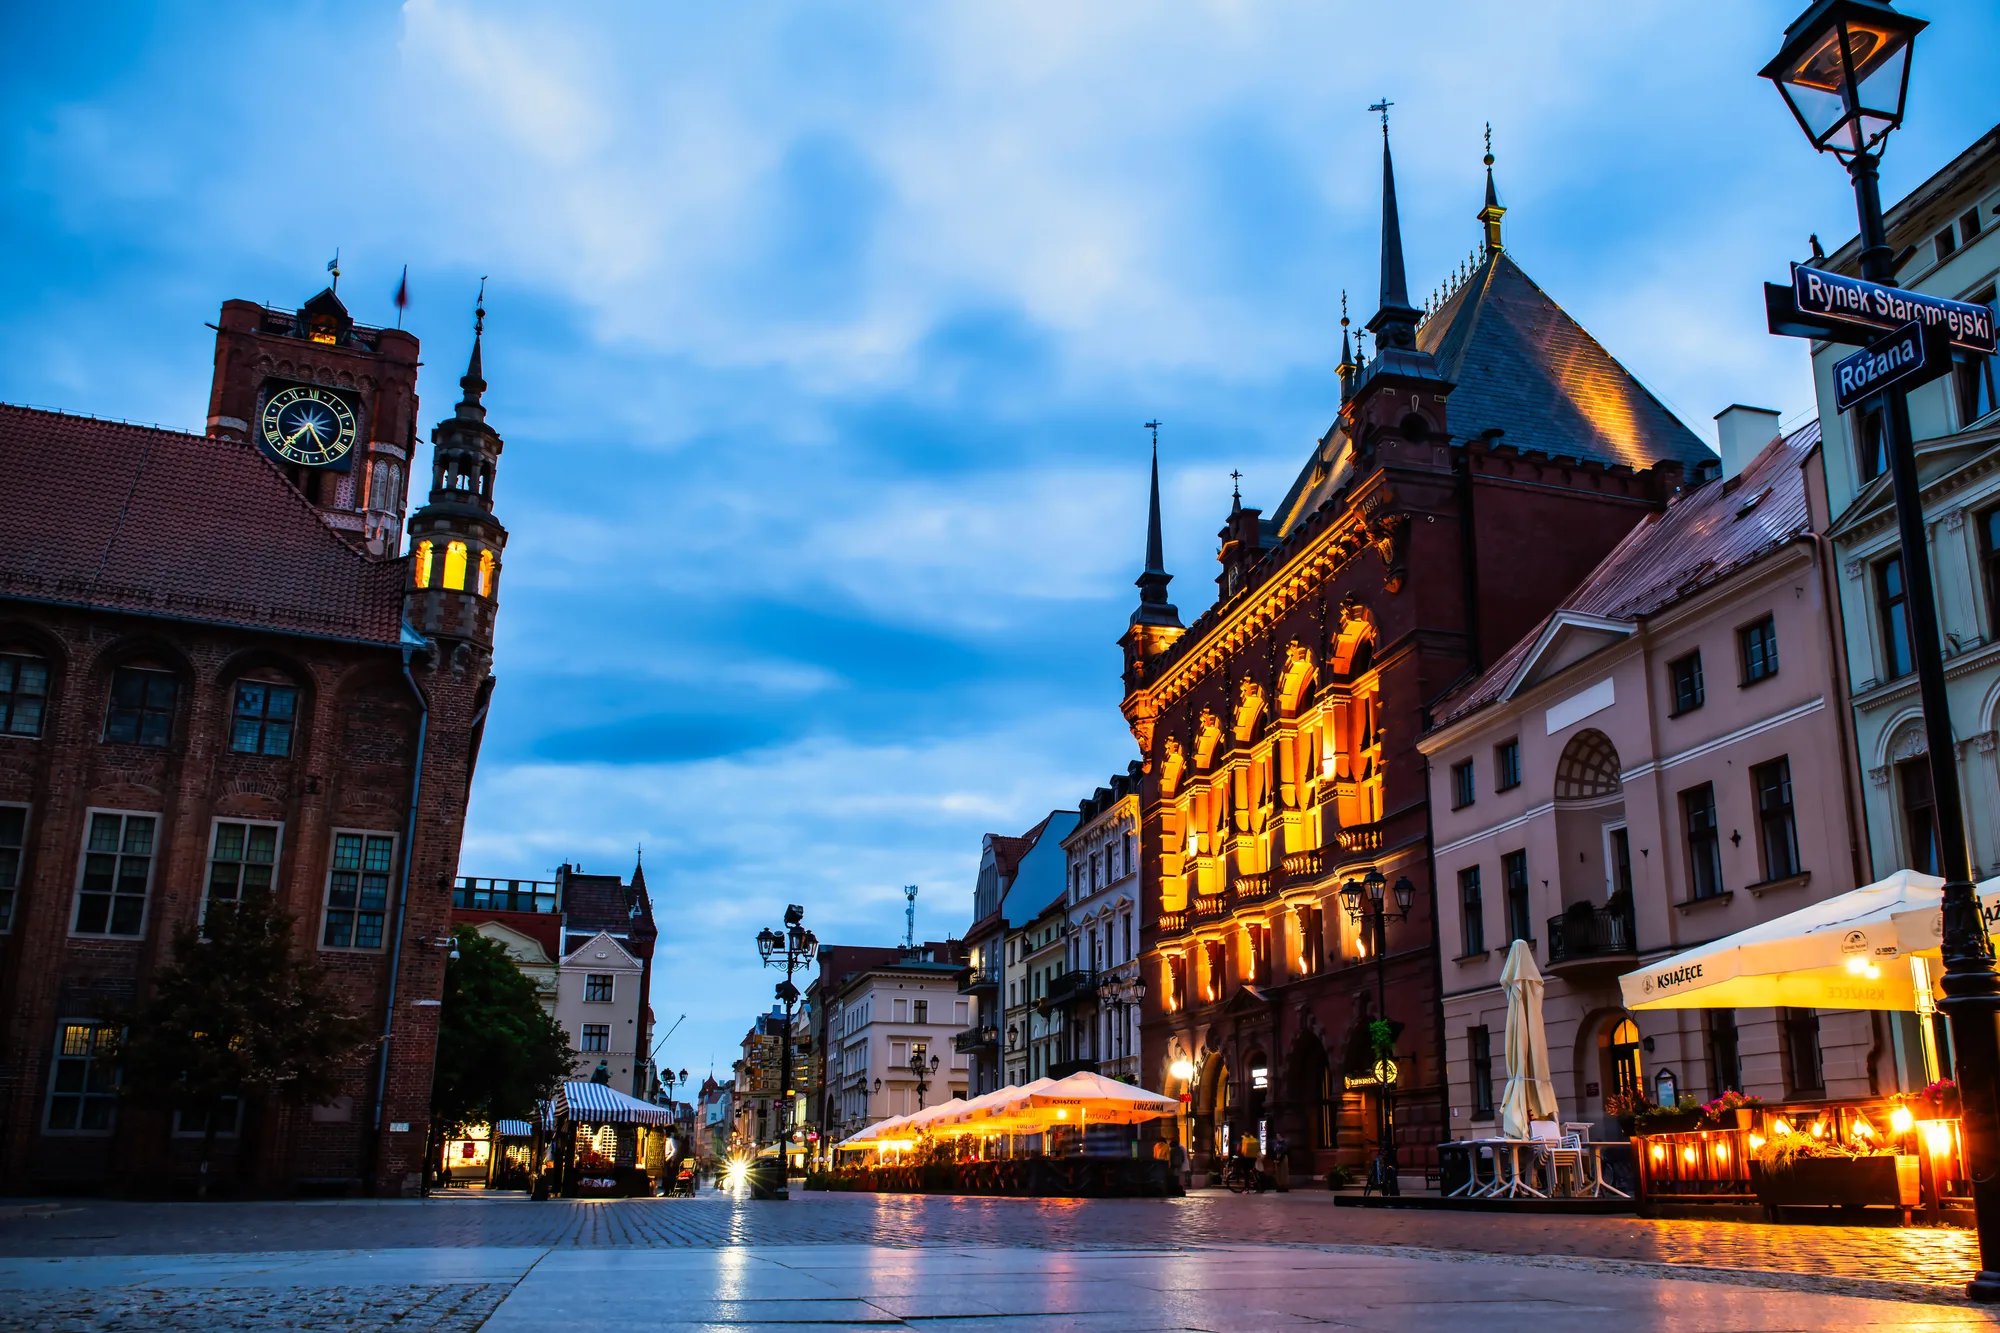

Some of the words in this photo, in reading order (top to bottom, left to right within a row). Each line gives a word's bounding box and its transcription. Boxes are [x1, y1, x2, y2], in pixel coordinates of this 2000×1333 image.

[1808, 273, 1871, 313] Rynek
[1873, 288, 1990, 341] Staromiejski
[1840, 338, 1915, 397] Różana
[288, 390, 298, 399] XI
[309, 389, 320, 399] XII
[329, 398, 336, 406] I
[301, 453, 310, 463] VI
[1657, 964, 1703, 988] KSIĄŻĘCE
[1133, 1103, 1164, 1111] LUIZJANA
